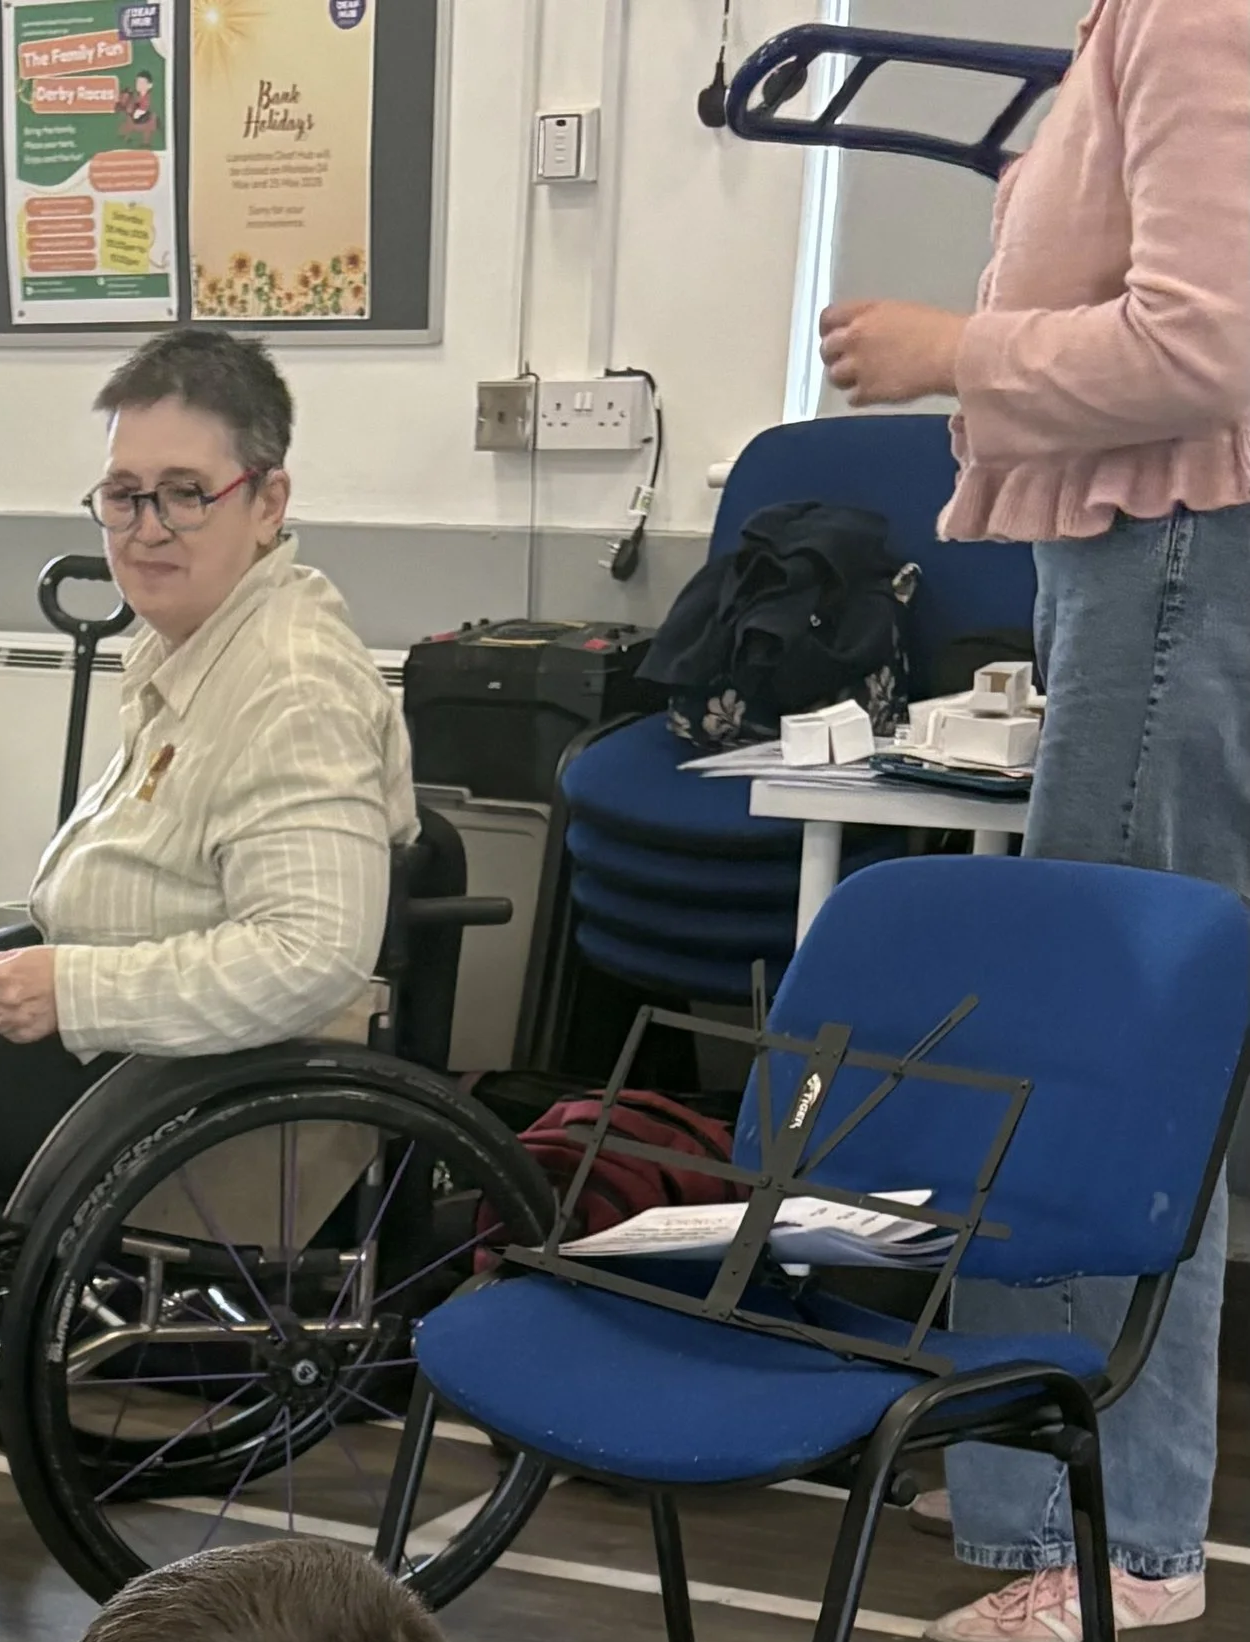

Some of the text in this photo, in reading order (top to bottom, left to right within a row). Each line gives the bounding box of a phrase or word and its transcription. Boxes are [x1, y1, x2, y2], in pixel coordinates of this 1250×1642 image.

[131, 17, 151, 27] HUB
[338, 9, 357, 18] HUB
[23, 41, 124, 68] The Family Fun
[36, 85, 115, 105] Derby Races
[257, 79, 300, 110] Bank
[243, 106, 315, 142] Holidays
[789, 1092, 813, 1128] TIGER
